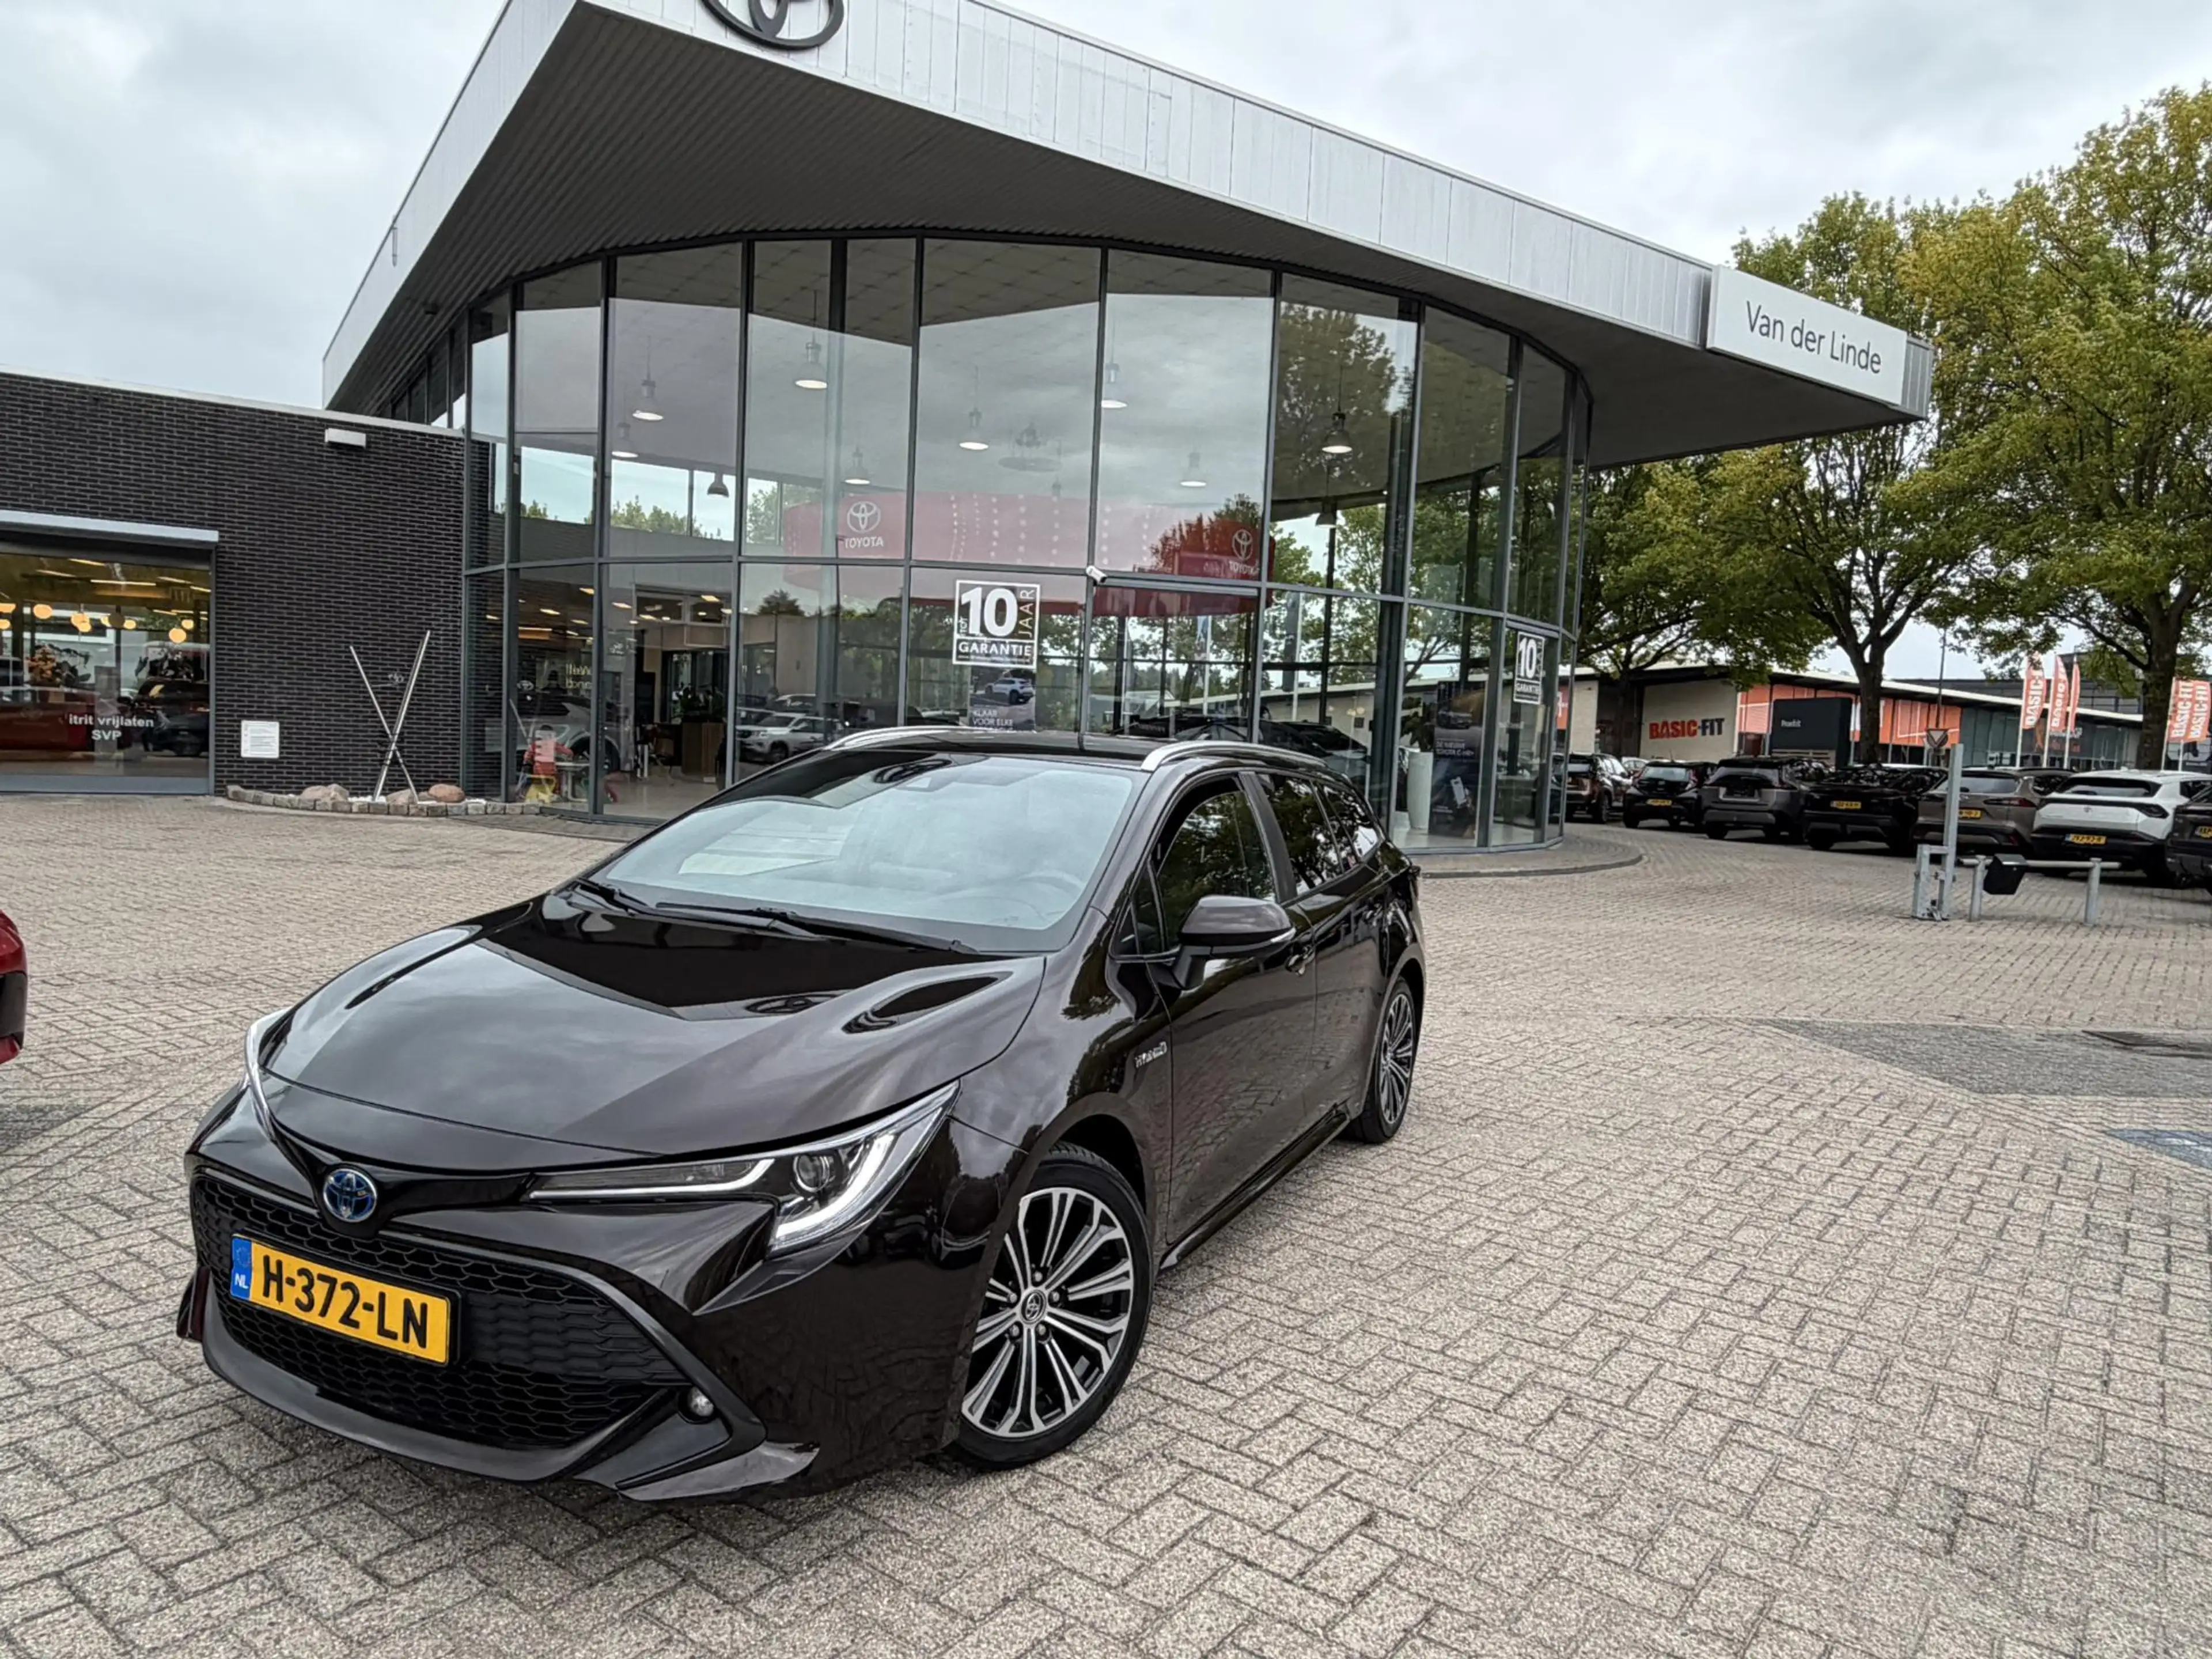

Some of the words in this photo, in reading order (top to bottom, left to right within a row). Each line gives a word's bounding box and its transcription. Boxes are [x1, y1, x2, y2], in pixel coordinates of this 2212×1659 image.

[1747, 300, 1784, 342] Van
[1791, 319, 1825, 355] der
[1831, 331, 1881, 374] Linde
[844, 536, 884, 548] TOYOTA
[961, 586, 1018, 637] 10
[1018, 589, 1035, 638] JAAR
[958, 641, 1032, 657] GARANTIE
[1519, 637, 1537, 679] 10
[97, 714, 154, 729] vrijlaten
[972, 718, 995, 726] VOOR
[1649, 718, 1725, 740] BASIC-FIT
[91, 729, 122, 741] SVP
[234, 1272, 249, 1290] NL
[262, 1254, 429, 1349] H-372-LN
